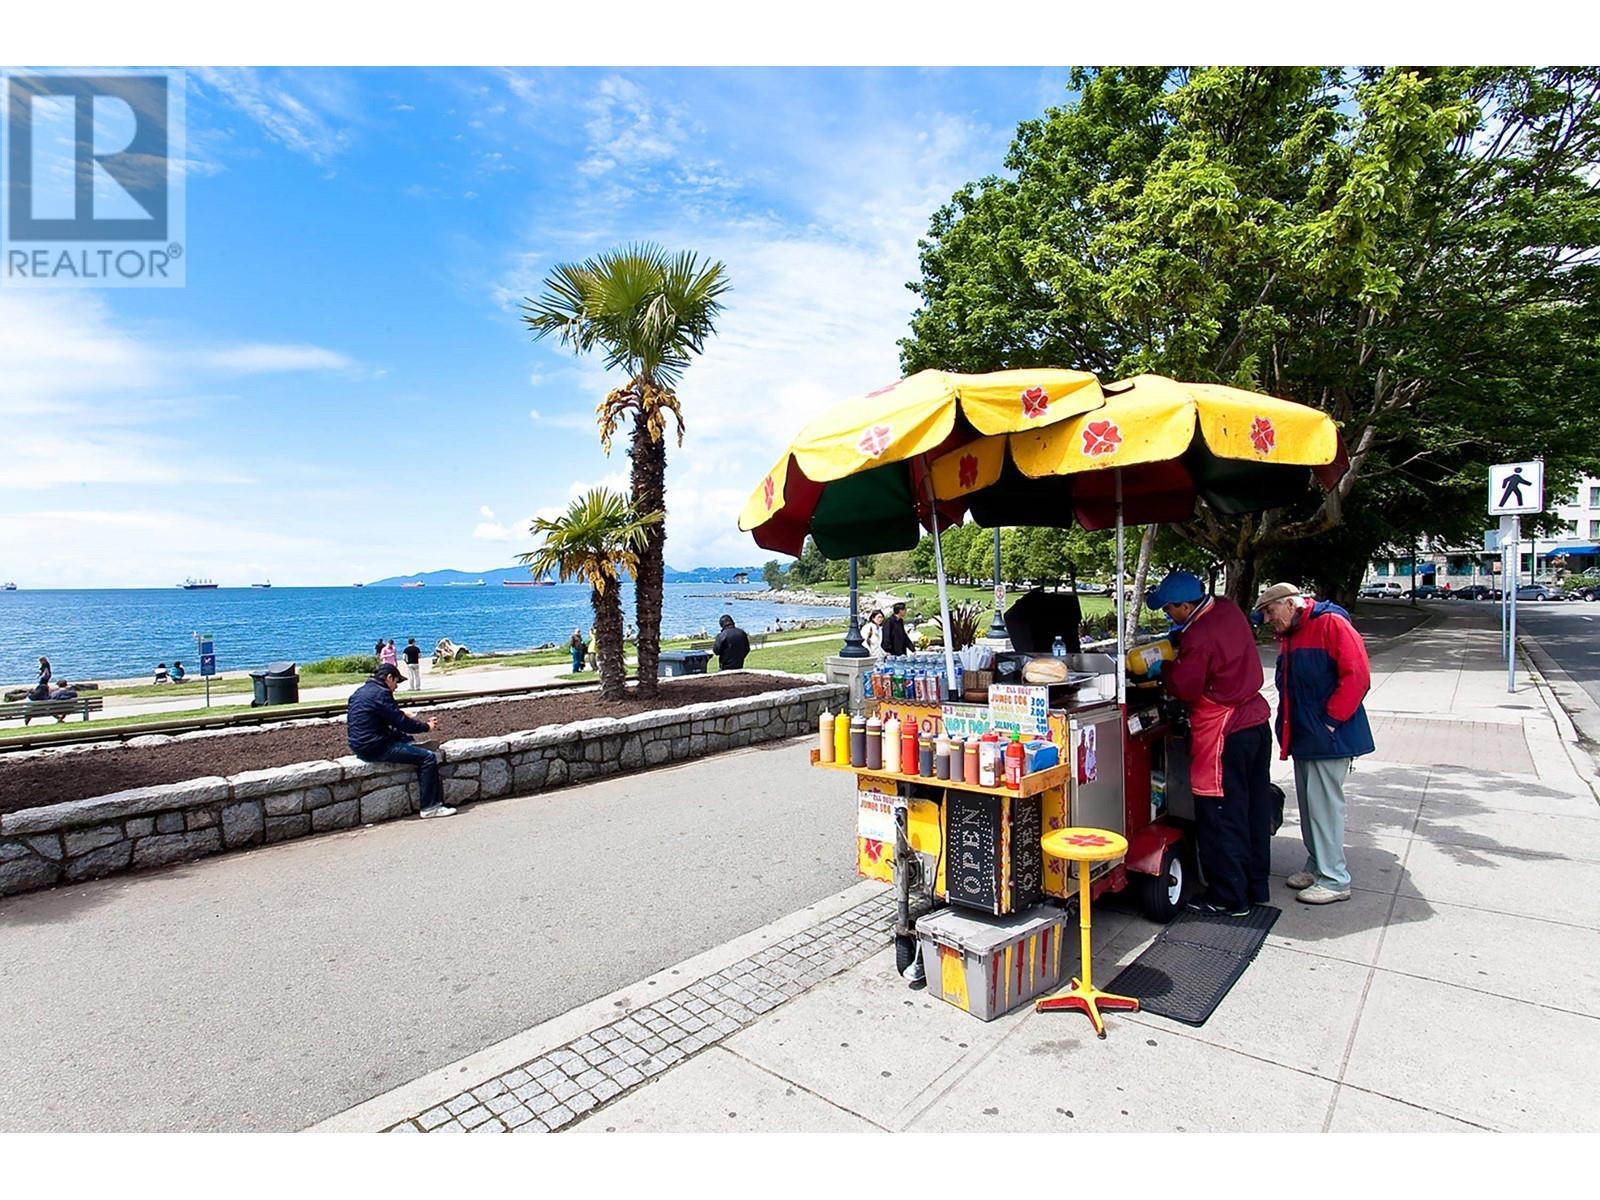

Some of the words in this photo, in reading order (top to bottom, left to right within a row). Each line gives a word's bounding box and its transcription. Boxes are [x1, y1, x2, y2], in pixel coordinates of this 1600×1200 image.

[991, 694, 1011, 704] JUMBO
[945, 717, 966, 733] HOT
[961, 805, 981, 894] OPEN
[1021, 806, 1035, 891] OPEN
